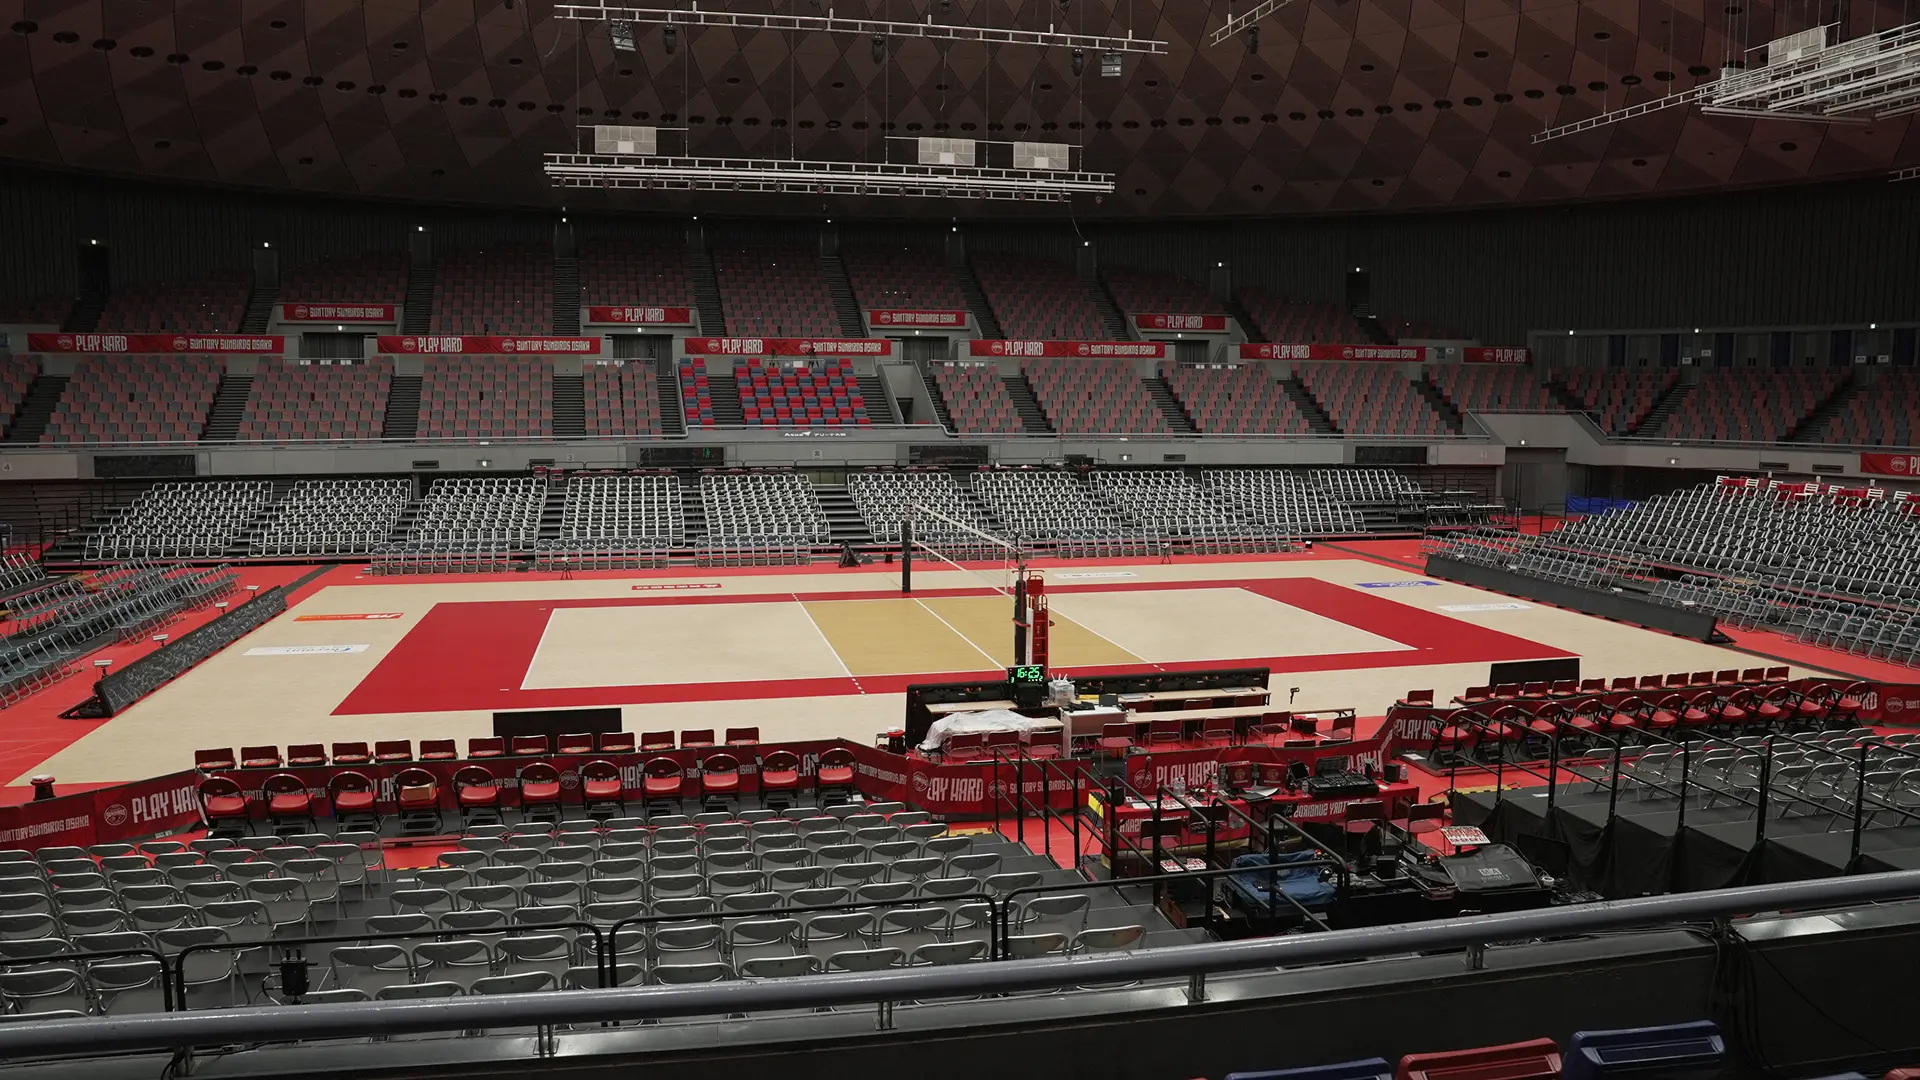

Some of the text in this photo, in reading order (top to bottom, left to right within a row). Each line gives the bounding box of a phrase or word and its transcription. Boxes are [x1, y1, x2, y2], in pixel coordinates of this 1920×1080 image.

[310, 307, 384, 318] SUNTORY SUNBIRDS OSAKA
[625, 308, 665, 322] PLAY HARD
[893, 313, 956, 323] SUNTORY SUNBIRDS OSAKA
[1167, 315, 1203, 328] PLAY HARD
[76, 335, 127, 351] PLAY HARD
[189, 338, 272, 350] SUNTORY SUNBIRDS OSAKA
[418, 338, 462, 352] PLAY HARD
[517, 341, 590, 351] SUNTORY SUNBIRDS OSAKA
[722, 339, 763, 353] PLAY HARD
[813, 342, 881, 353] SUNTORY SUNBIRDS OSAKA
[1004, 342, 1043, 355] PLAY HARD
[1091, 344, 1155, 355] SUNTORY SUNBIRDS OSAKA
[1272, 345, 1310, 359] PLAY HARD
[1496, 349, 1513, 362] PLAY
[1017, 667, 1040, 678] 16:25
[1395, 719, 1421, 739] PLAY
[1156, 763, 1186, 788] PLAY
[950, 777, 983, 801] HARD
[132, 794, 171, 823] PLAY
[28, 817, 65, 838] SUNBIRDS
[65, 814, 90, 831] OSAKA
